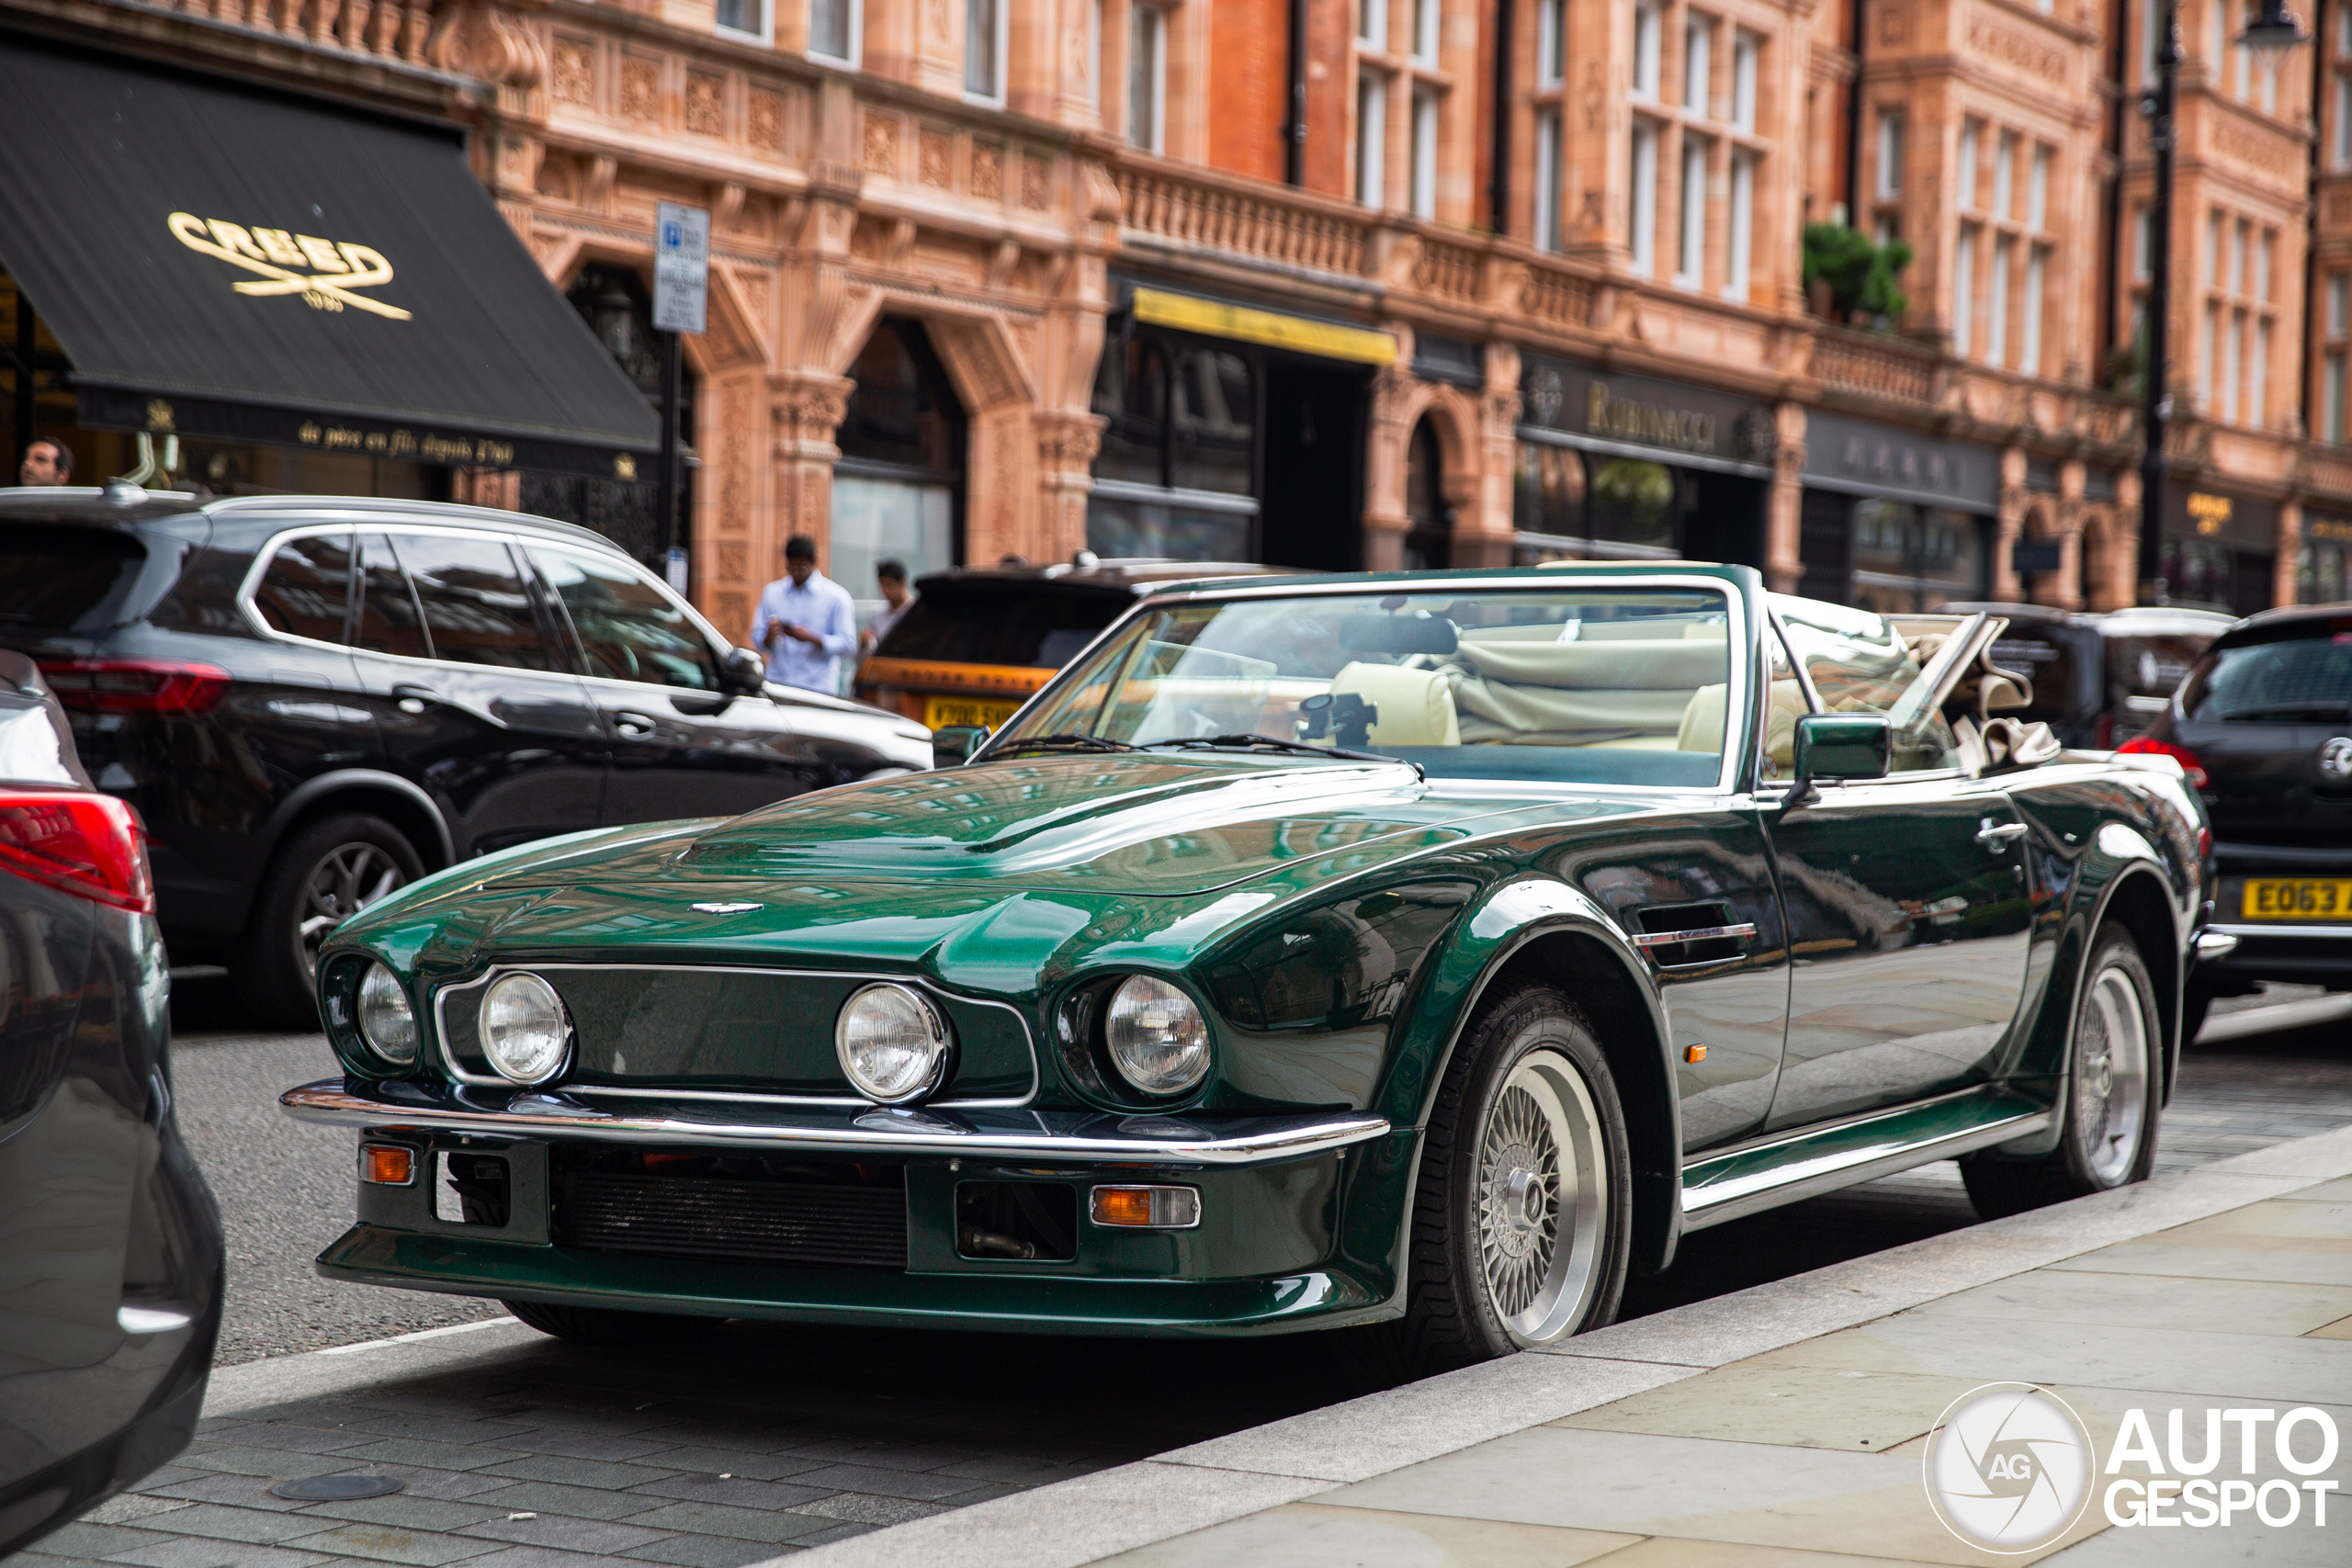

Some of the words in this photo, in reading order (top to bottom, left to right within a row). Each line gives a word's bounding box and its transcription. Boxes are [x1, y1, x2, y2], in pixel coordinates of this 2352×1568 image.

[168, 212, 401, 299] CREED
[299, 420, 322, 445] de
[365, 432, 388, 451] en
[388, 429, 418, 457] fils
